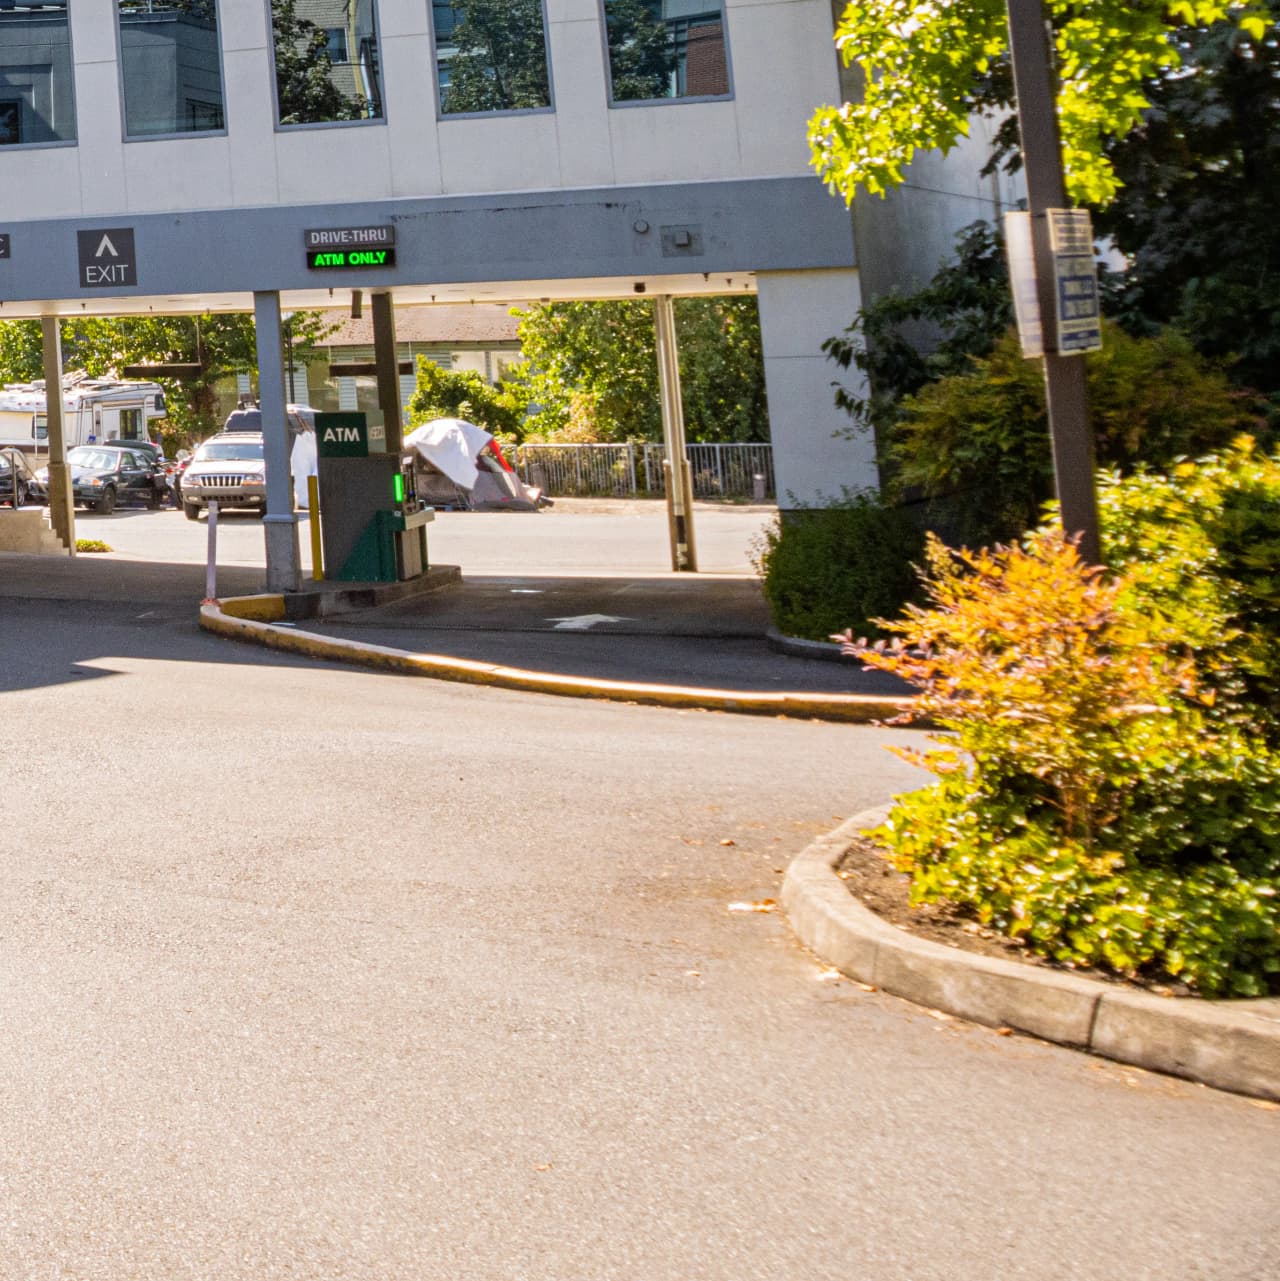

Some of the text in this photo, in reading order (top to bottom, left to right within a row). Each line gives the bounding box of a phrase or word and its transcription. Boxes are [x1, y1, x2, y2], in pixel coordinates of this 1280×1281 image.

[311, 229, 387, 244] DRIVE-THRU
[314, 251, 386, 266] ATM ONLY
[86, 264, 129, 283] EXIT
[323, 428, 360, 442] ATM
